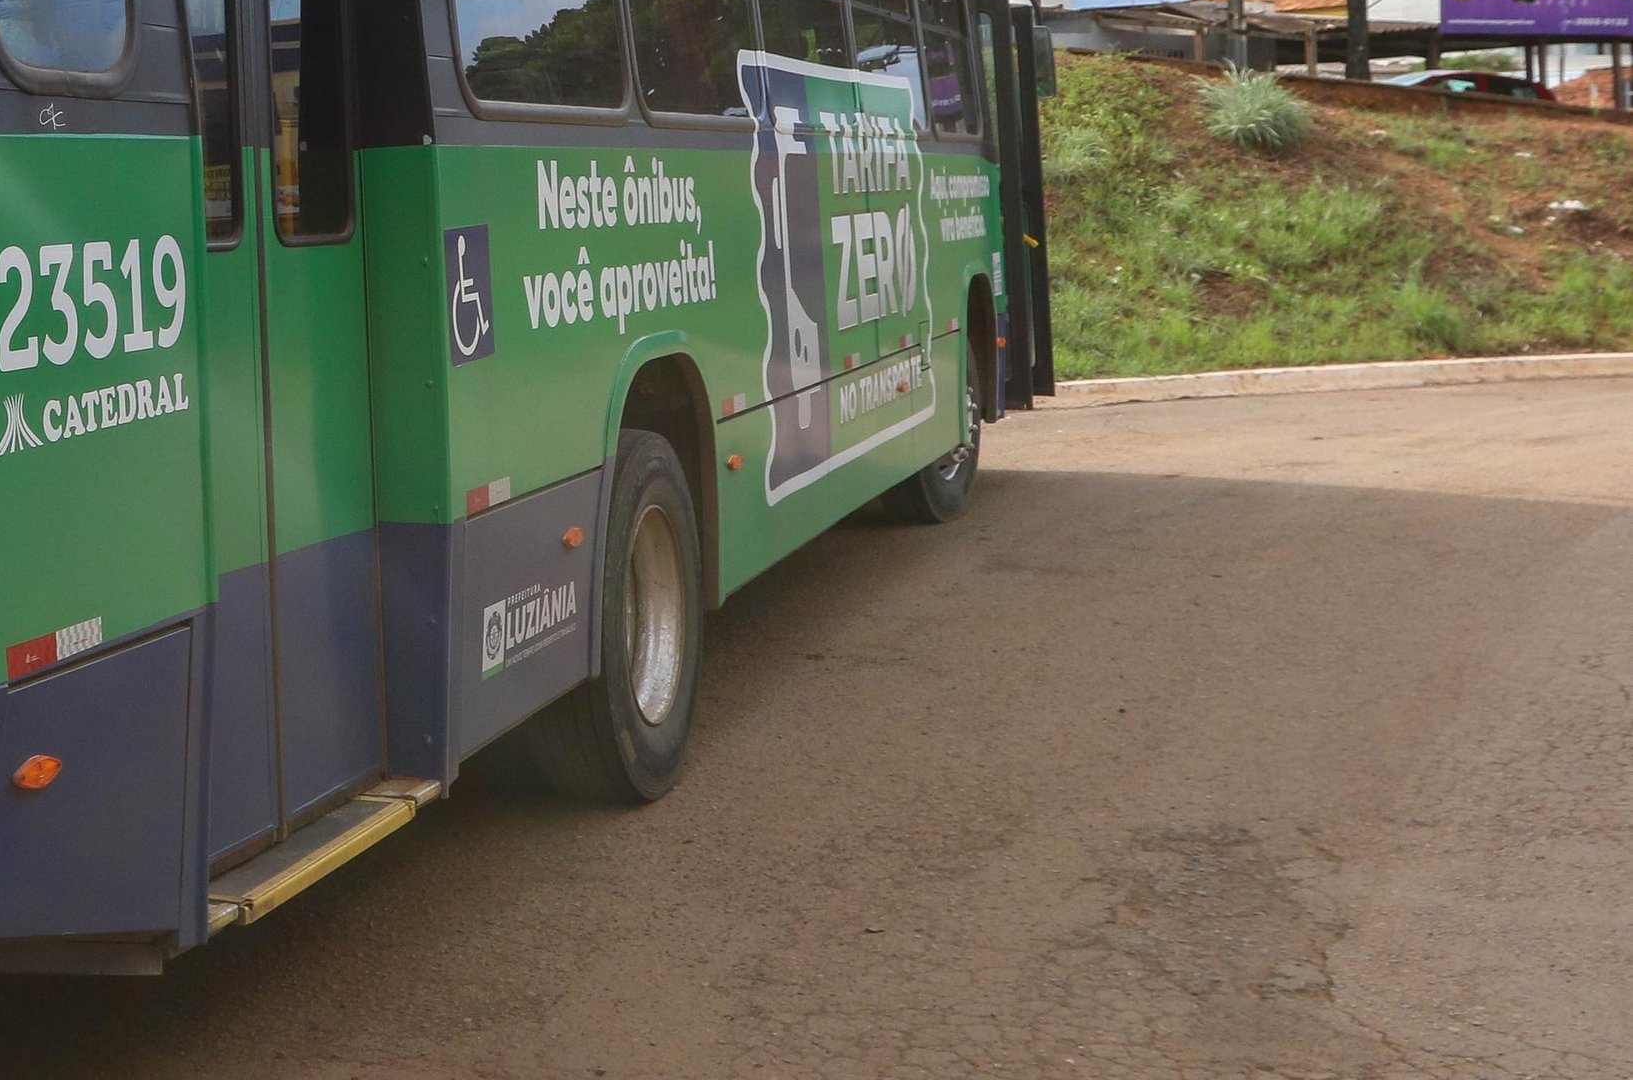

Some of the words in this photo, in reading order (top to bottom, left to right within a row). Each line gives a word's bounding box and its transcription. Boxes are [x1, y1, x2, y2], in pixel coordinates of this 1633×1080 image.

[819, 111, 912, 194] TARIFA
[537, 160, 617, 230] Neste
[623, 155, 702, 235] ônibus,
[523, 246, 594, 329] você
[600, 239, 716, 335] aproveita!
[42, 373, 189, 443] CATEDRAL
[840, 382, 856, 424] NO
[506, 580, 576, 650] LUZIÂNIA
